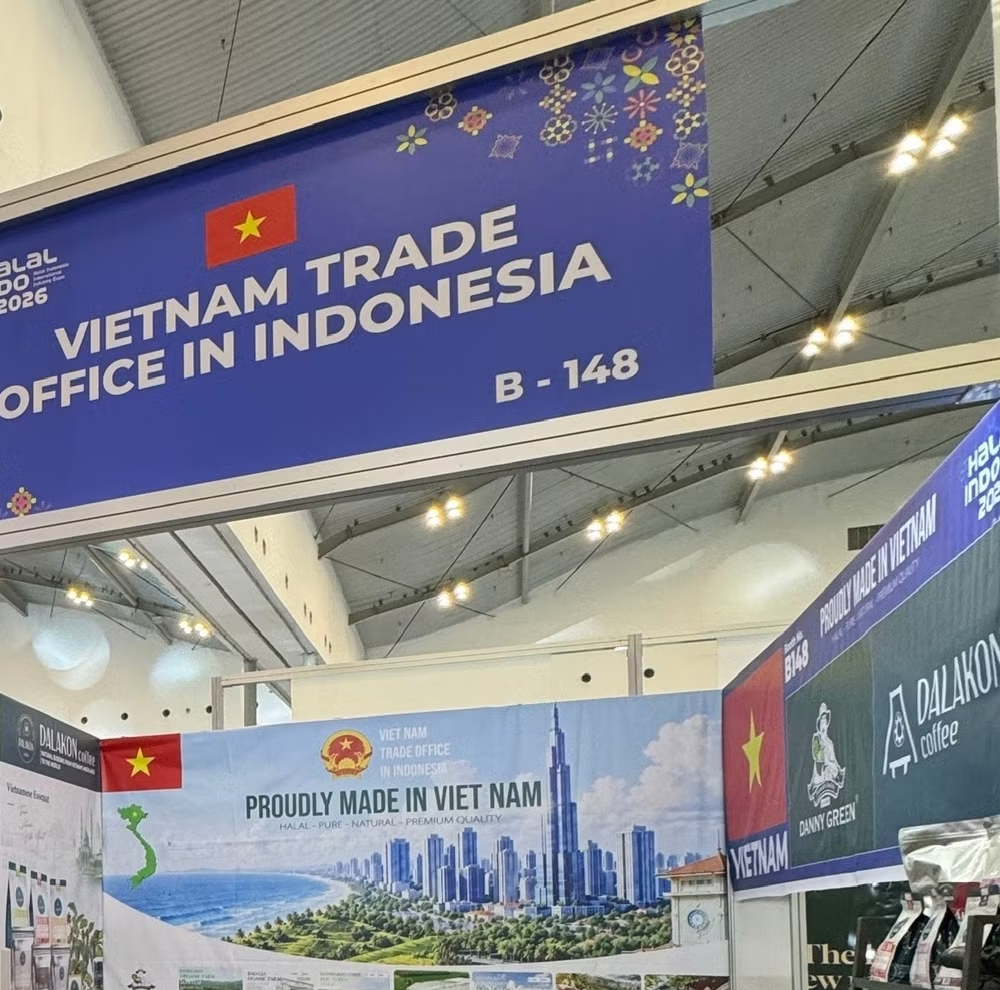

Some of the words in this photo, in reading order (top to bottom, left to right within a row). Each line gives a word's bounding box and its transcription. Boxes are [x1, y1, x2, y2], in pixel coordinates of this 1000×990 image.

[54, 267, 288, 360] VIETNAM
[305, 204, 518, 296] TRADE
[183, 330, 235, 380] IN
[254, 241, 612, 362] INDONESIA
[495, 370, 524, 404] B
[562, 348, 639, 390] 148
[968, 434, 1000, 478] HAL
[978, 480, 1000, 521] 202
[819, 578, 852, 638] PROUDLY
[852, 554, 877, 608] MADE
[877, 541, 889, 584] IN
[889, 492, 937, 572] VIETNAM
[784, 639, 809, 683] B148
[917, 633, 1000, 726] DALAKON
[39, 723, 78, 761] DALAKON
[379, 727, 401, 741] VIET
[403, 726, 427, 740] NAM
[380, 745, 413, 760] TRADE
[415, 743, 451, 757] OFFICE
[920, 720, 959, 759] coffee
[380, 765, 391, 778] IN
[393, 762, 448, 778] INDONESIA
[245, 791, 333, 819] PROUDLY
[340, 788, 400, 815] MADE
[406, 786, 427, 812] IN
[434, 784, 482, 811] VIET
[489, 781, 542, 809] NAM
[799, 814, 825, 838] DANNY
[825, 801, 857, 828] GREEN
[280, 822, 310, 831] HALAL
[319, 819, 343, 829] PURE
[352, 818, 397, 828] NATURAL
[406, 816, 454, 826] PREMIUM
[456, 814, 502, 825] QUALITY
[730, 830, 788, 881] VIETNAM
[808, 974, 842, 990] ew
